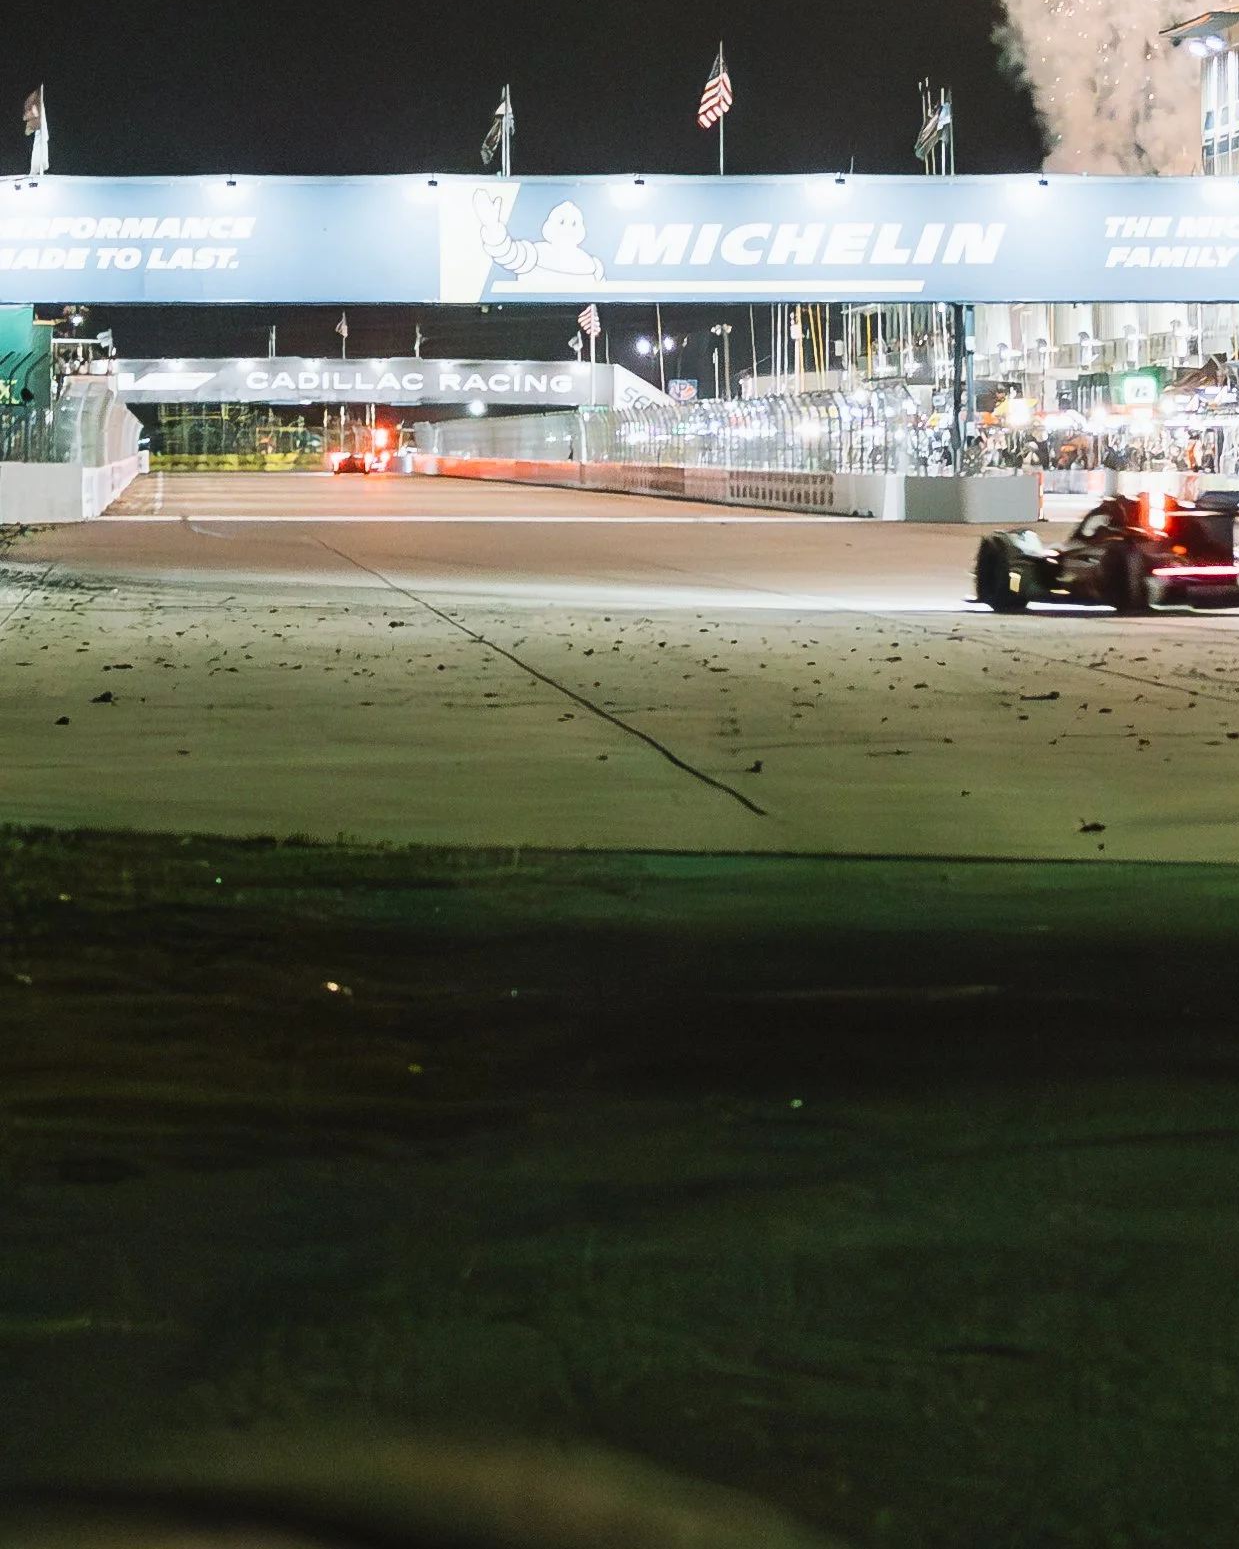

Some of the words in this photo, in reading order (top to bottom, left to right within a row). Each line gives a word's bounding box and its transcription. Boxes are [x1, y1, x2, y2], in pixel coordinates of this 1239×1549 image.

[0, 216, 256, 239] ERFORMANCE
[1104, 215, 1173, 238] THE
[613, 223, 1007, 266] MICHELIN
[96, 247, 142, 270] TO
[146, 247, 239, 270] LAST.
[246, 371, 424, 392] CADILLAC
[438, 372, 574, 393] RACING
